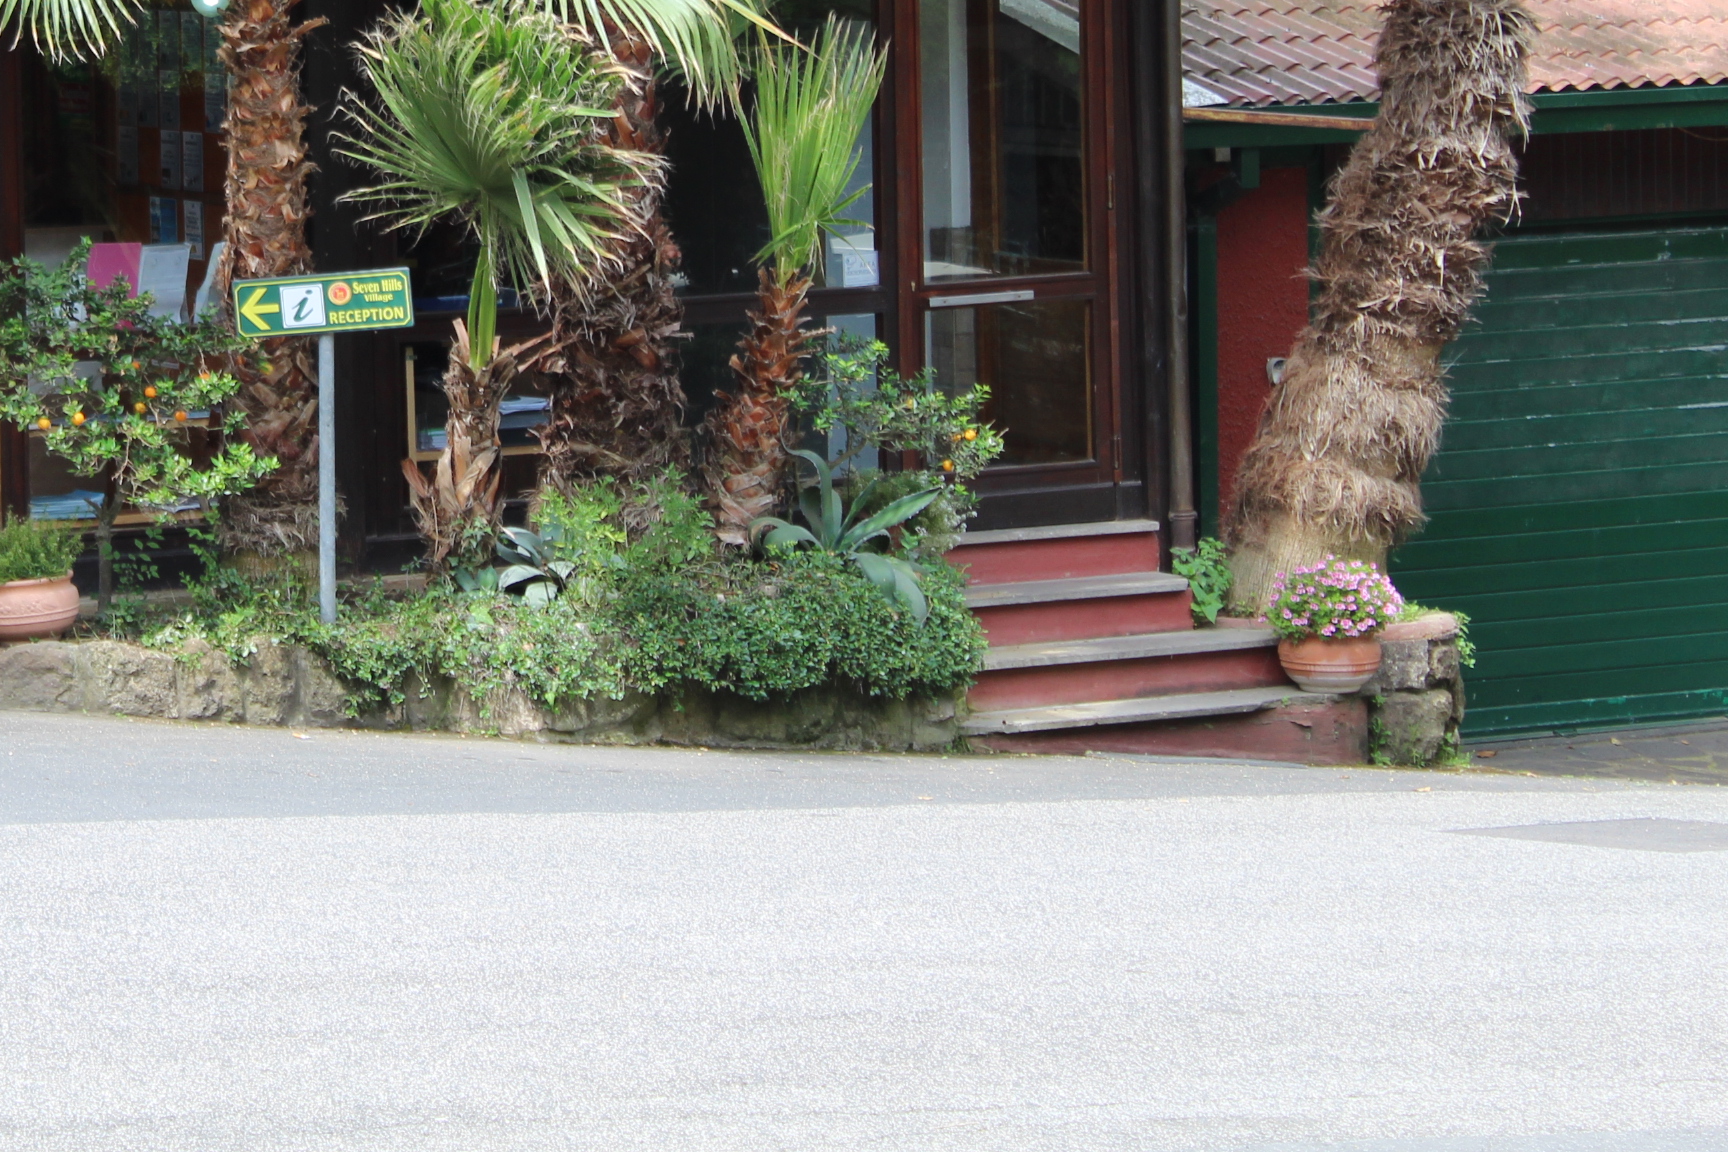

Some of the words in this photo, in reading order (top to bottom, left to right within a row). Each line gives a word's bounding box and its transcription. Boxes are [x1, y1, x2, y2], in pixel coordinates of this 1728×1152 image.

[353, 281, 379, 294] Seven
[381, 278, 403, 292] Hills
[364, 293, 393, 303] Village
[329, 307, 404, 324] RECEPTION
